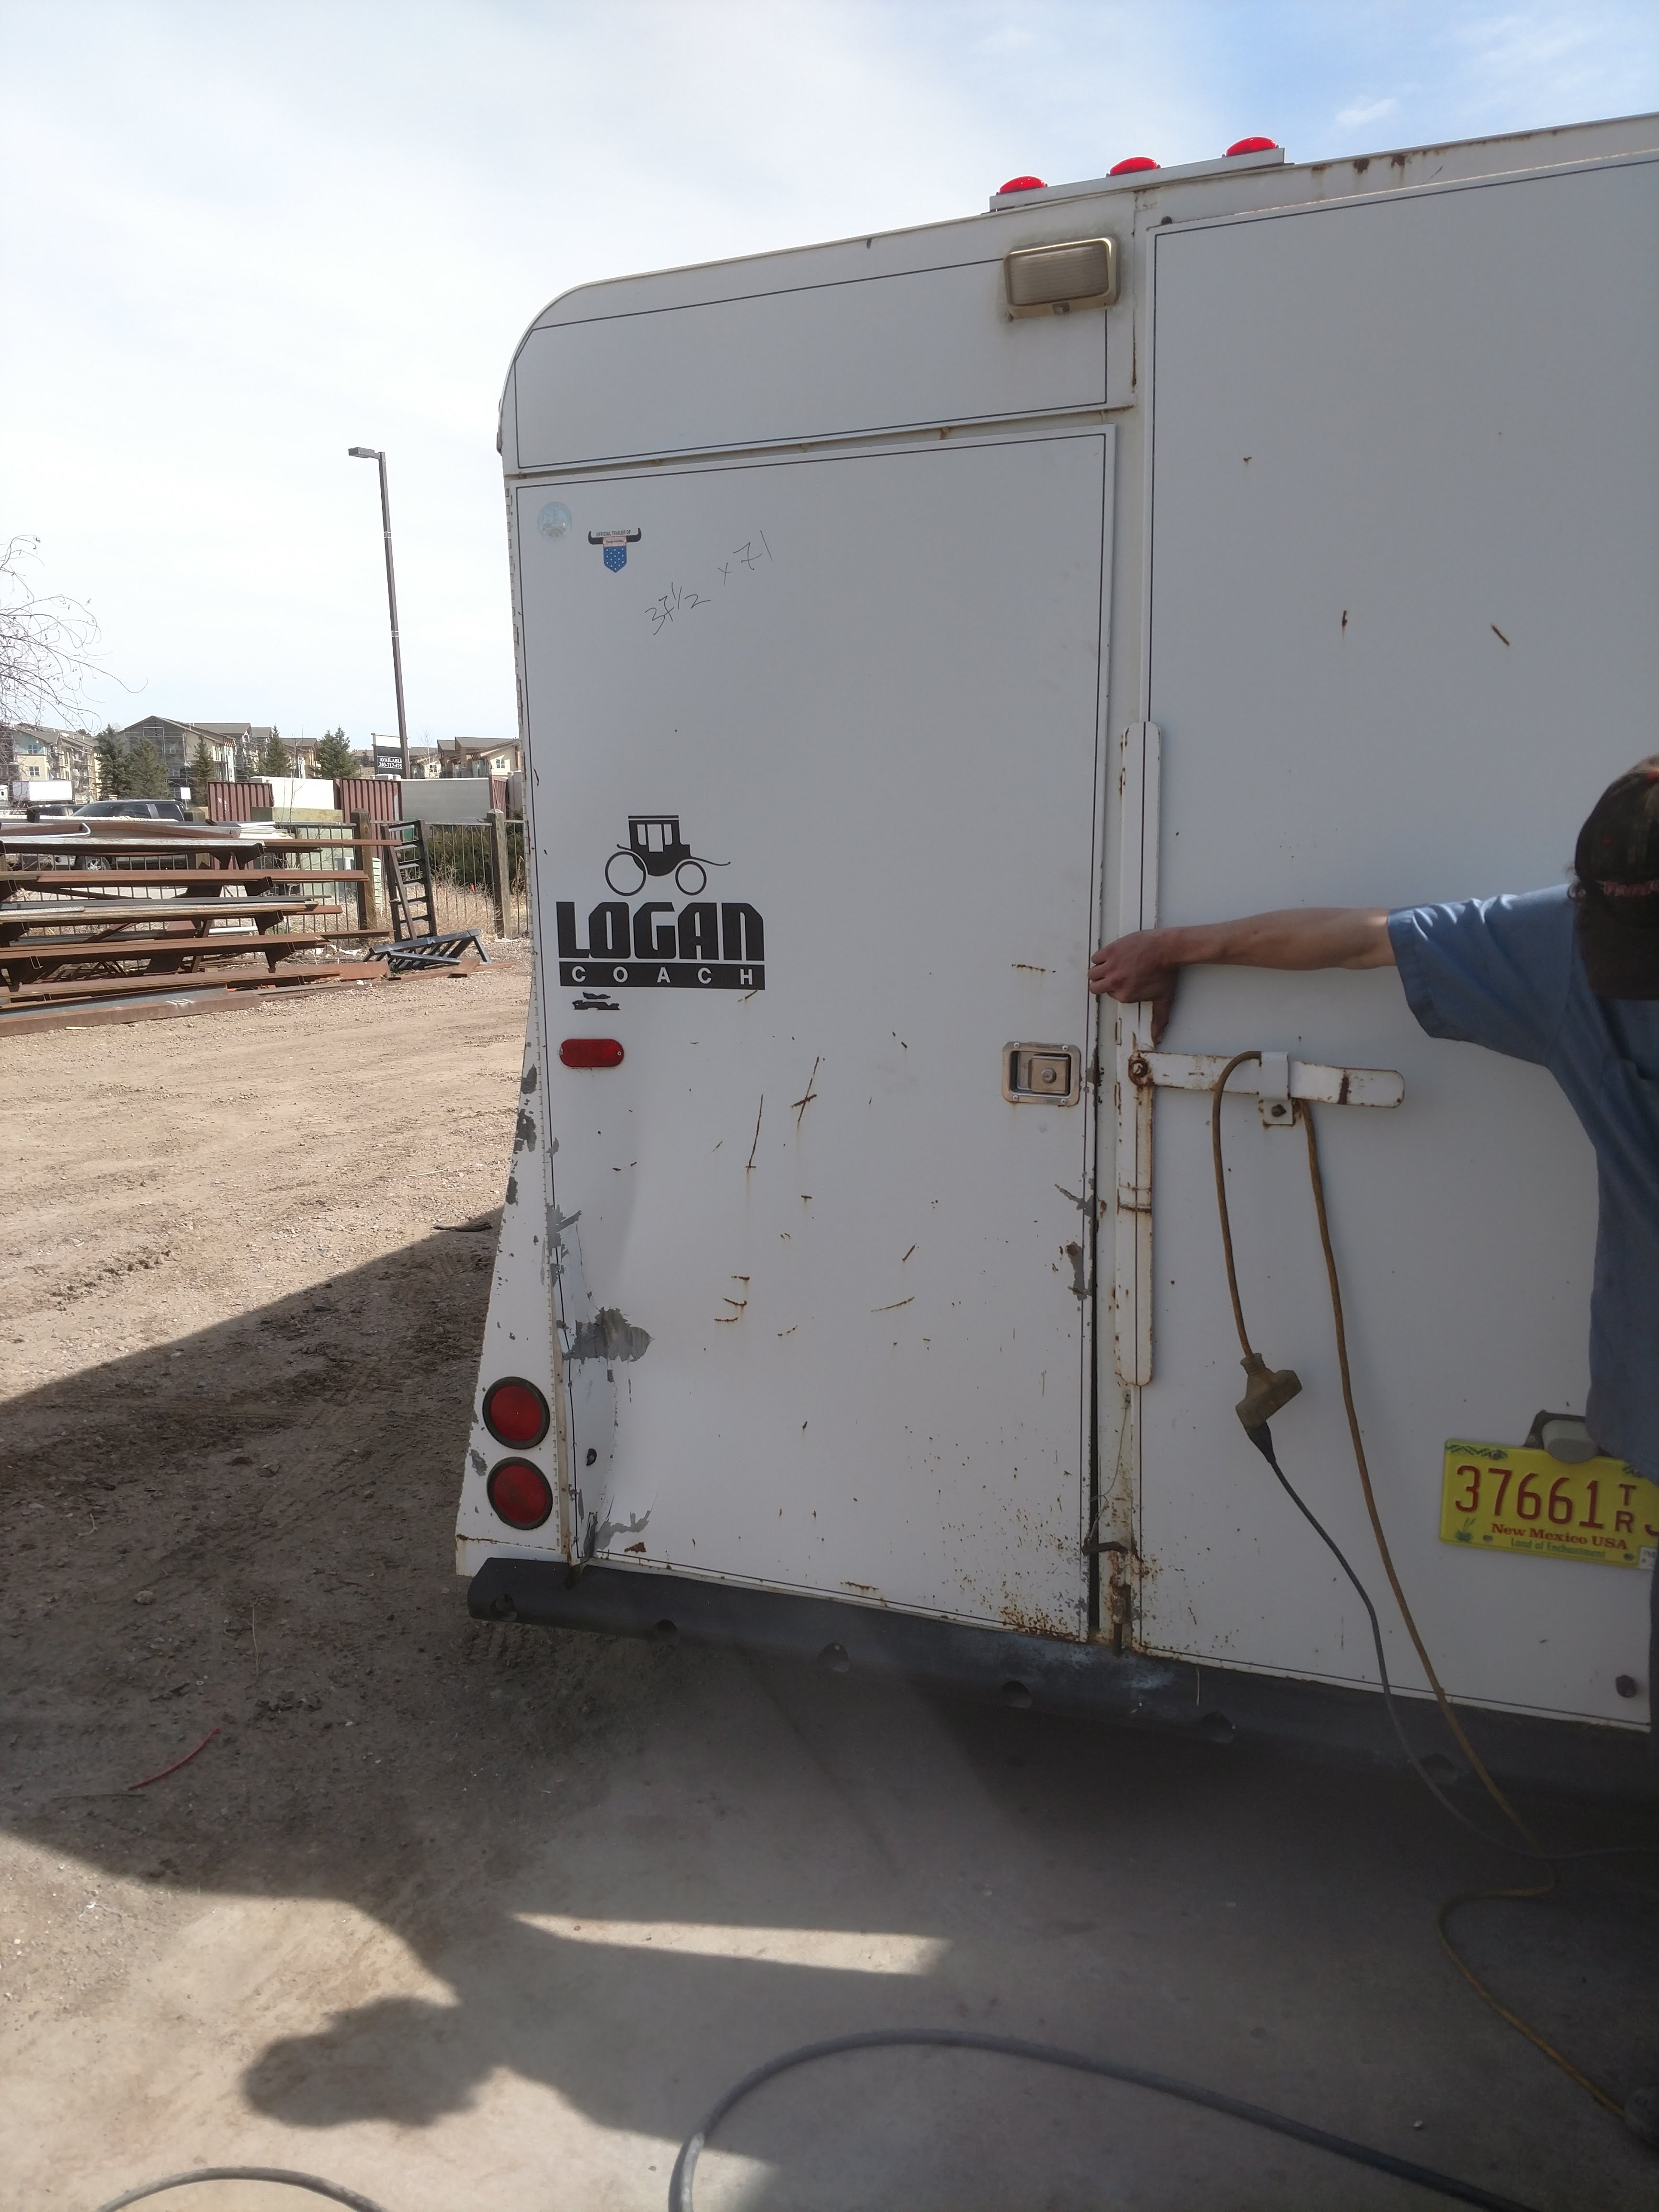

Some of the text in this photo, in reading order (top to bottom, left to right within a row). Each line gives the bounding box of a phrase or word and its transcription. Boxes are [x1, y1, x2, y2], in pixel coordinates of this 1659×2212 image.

[556, 901, 765, 961] LOGAN
[571, 966, 753, 985] COACH
[1455, 1465, 1604, 1529] 37661
[1491, 1523, 1628, 1550] New Mexico USA
